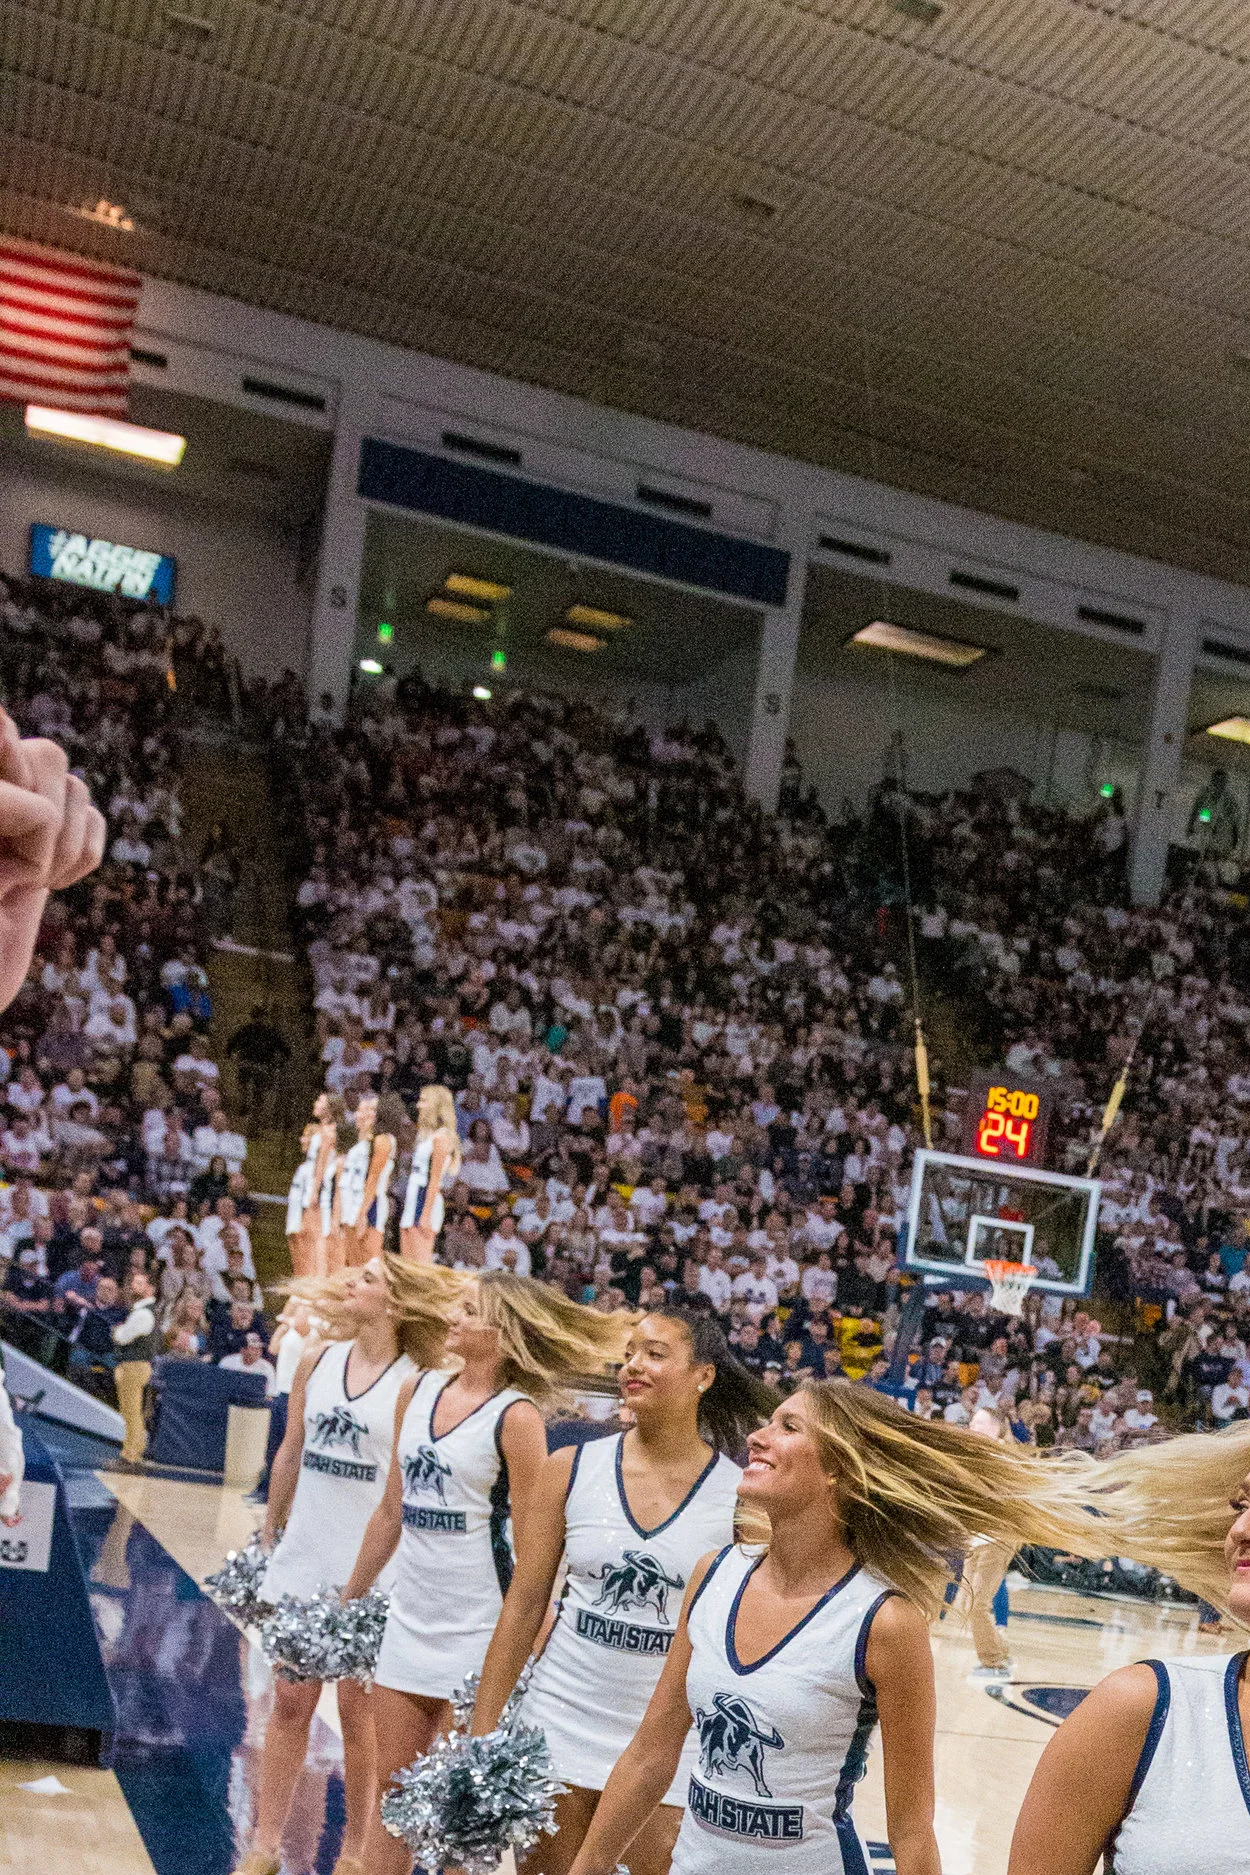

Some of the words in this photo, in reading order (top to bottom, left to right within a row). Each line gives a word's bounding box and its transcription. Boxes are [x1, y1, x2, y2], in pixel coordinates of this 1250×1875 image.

[987, 1087, 1040, 1120] 15:00
[978, 1112, 1031, 1158] 24
[330, 1458, 377, 1481] STATE
[417, 1507, 467, 1533] STATE
[577, 1608, 628, 1649] UTAH
[624, 1624, 676, 1655] STAT
[720, 1796, 803, 1840] STATE
